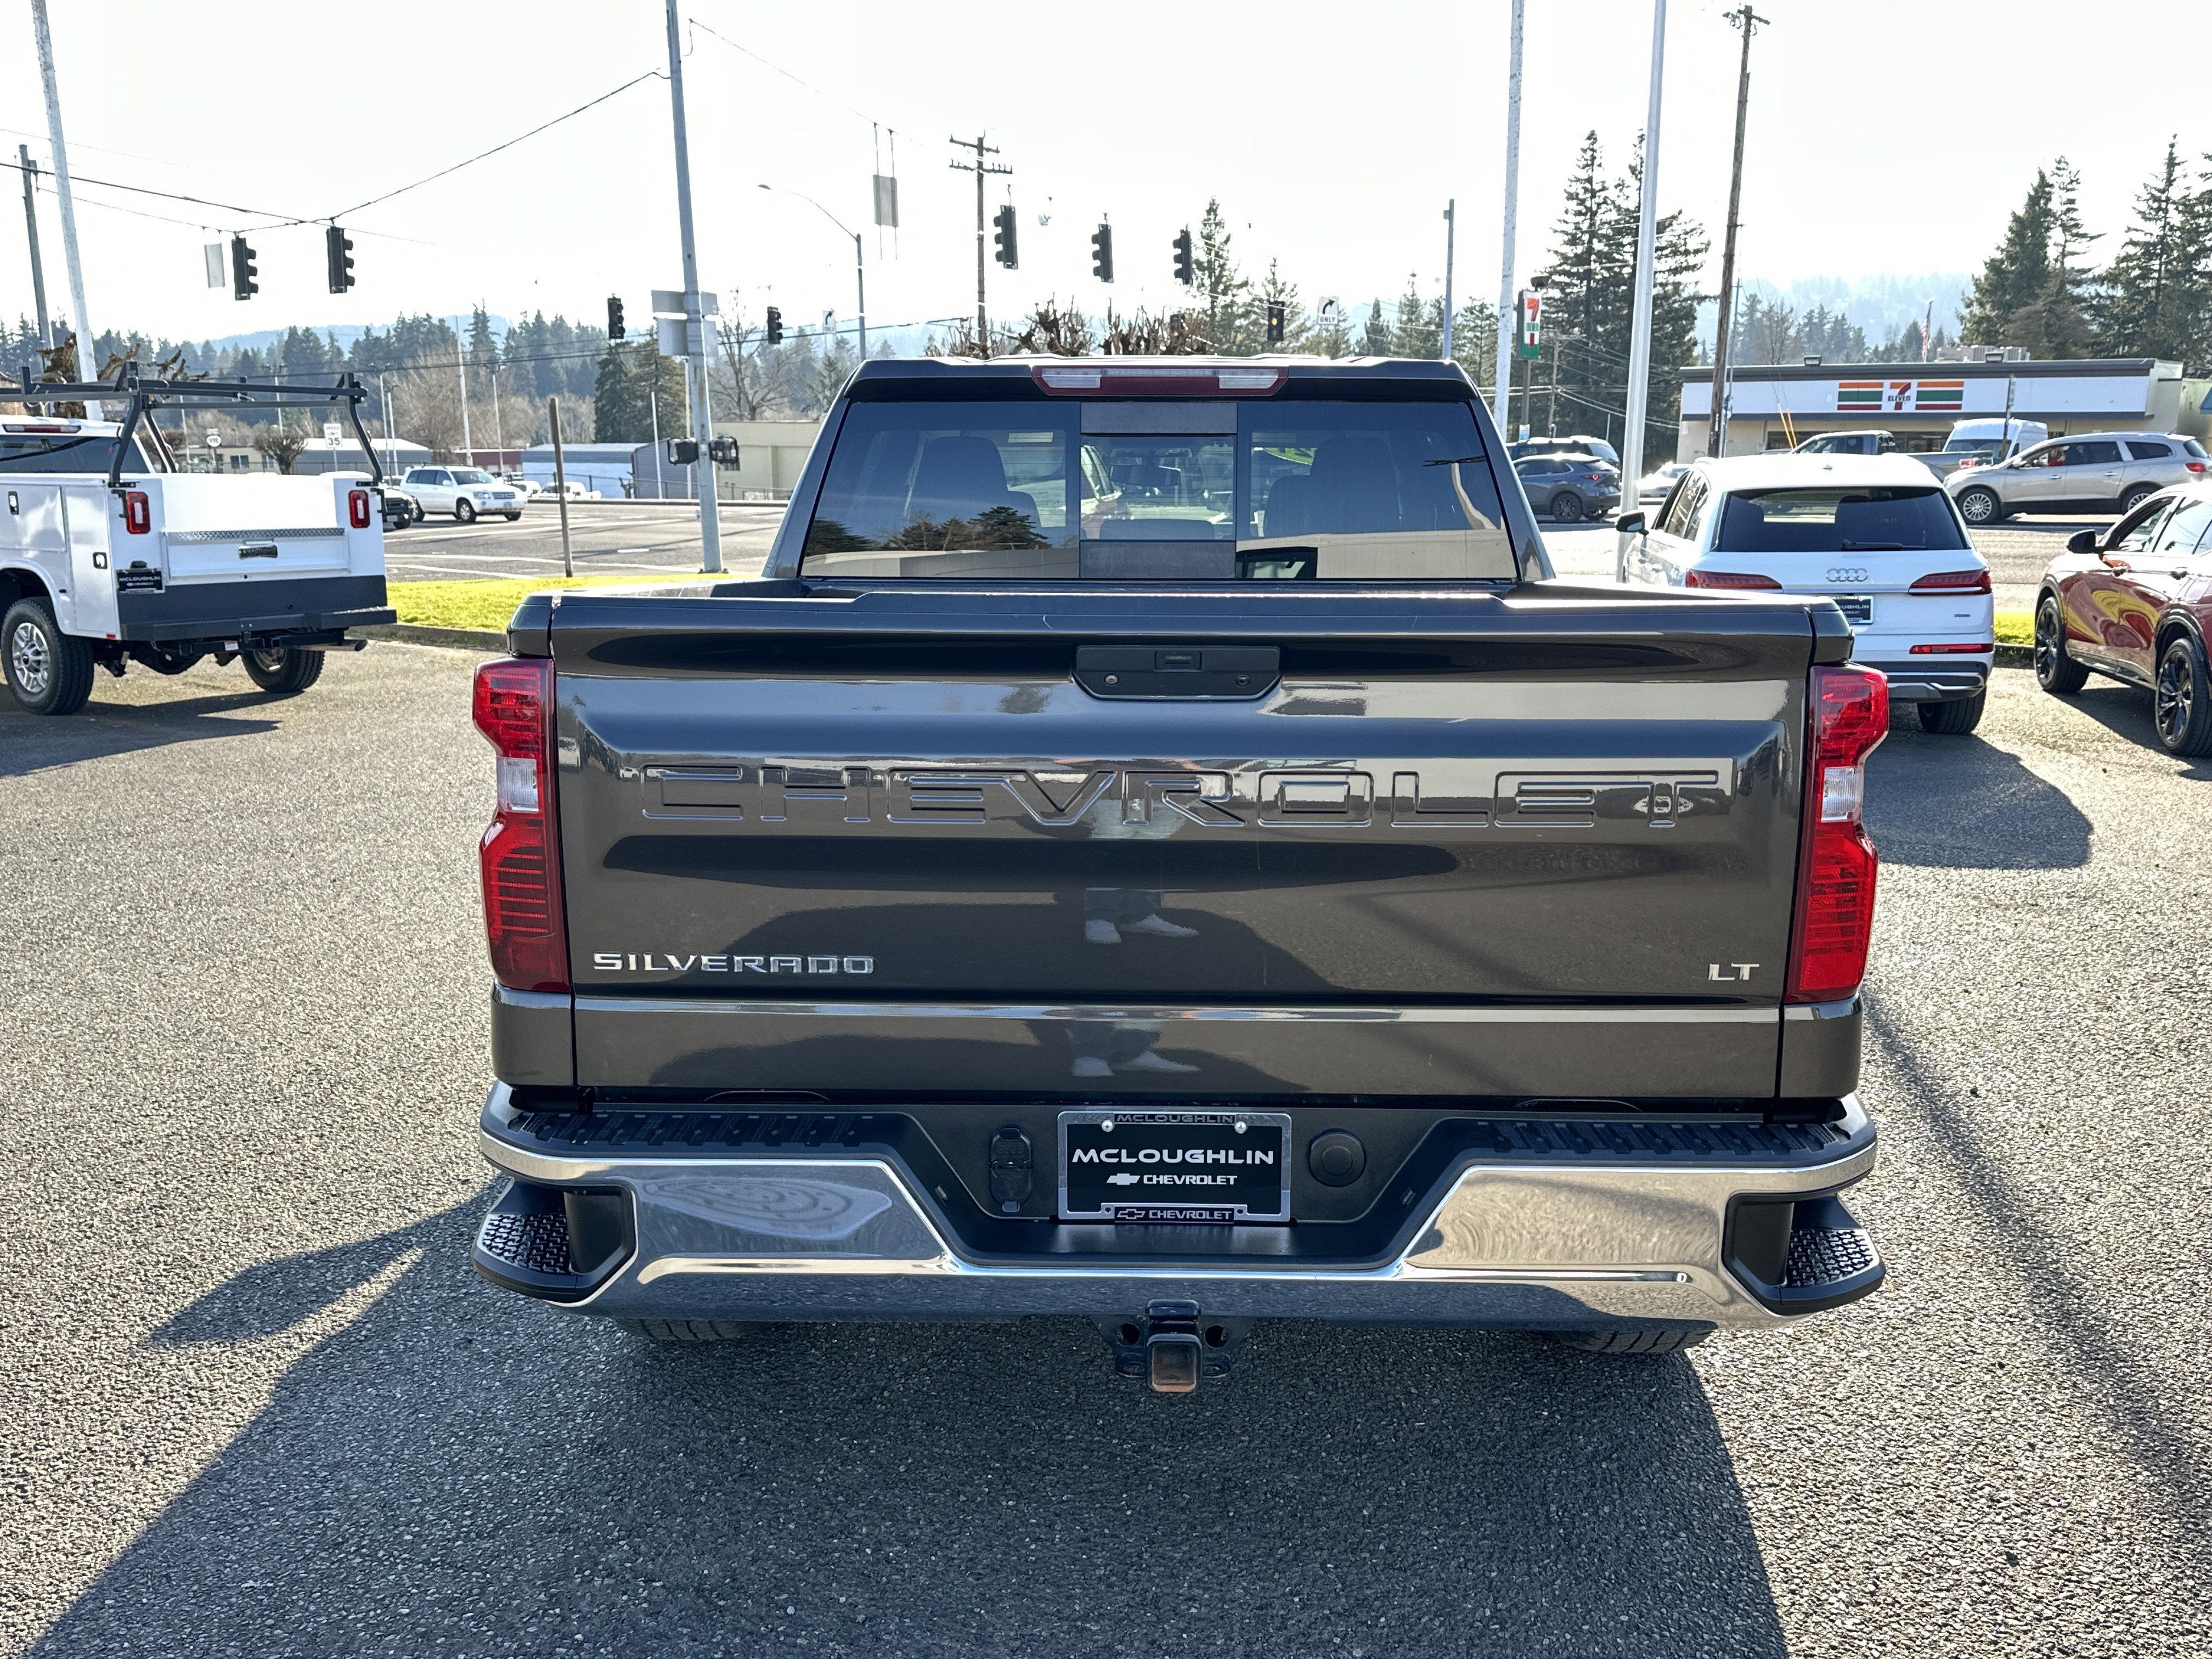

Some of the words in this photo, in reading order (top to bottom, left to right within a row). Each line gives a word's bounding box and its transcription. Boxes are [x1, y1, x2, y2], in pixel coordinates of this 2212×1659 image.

[1527, 298, 1539, 348] 7
[1890, 382, 1911, 410] 7
[328, 437, 340, 445] 35
[641, 763, 1719, 828] CHEVROLET
[592, 951, 875, 974] SILVERADO
[1707, 963, 1760, 980] LT
[1116, 1114, 1233, 1124] MCLOUGHLIN
[1072, 1149, 1273, 1165] MCLOUGHLIN
[1143, 1175, 1238, 1185] CHEVROLET
[1148, 1210, 1232, 1220] CHEVROLET
